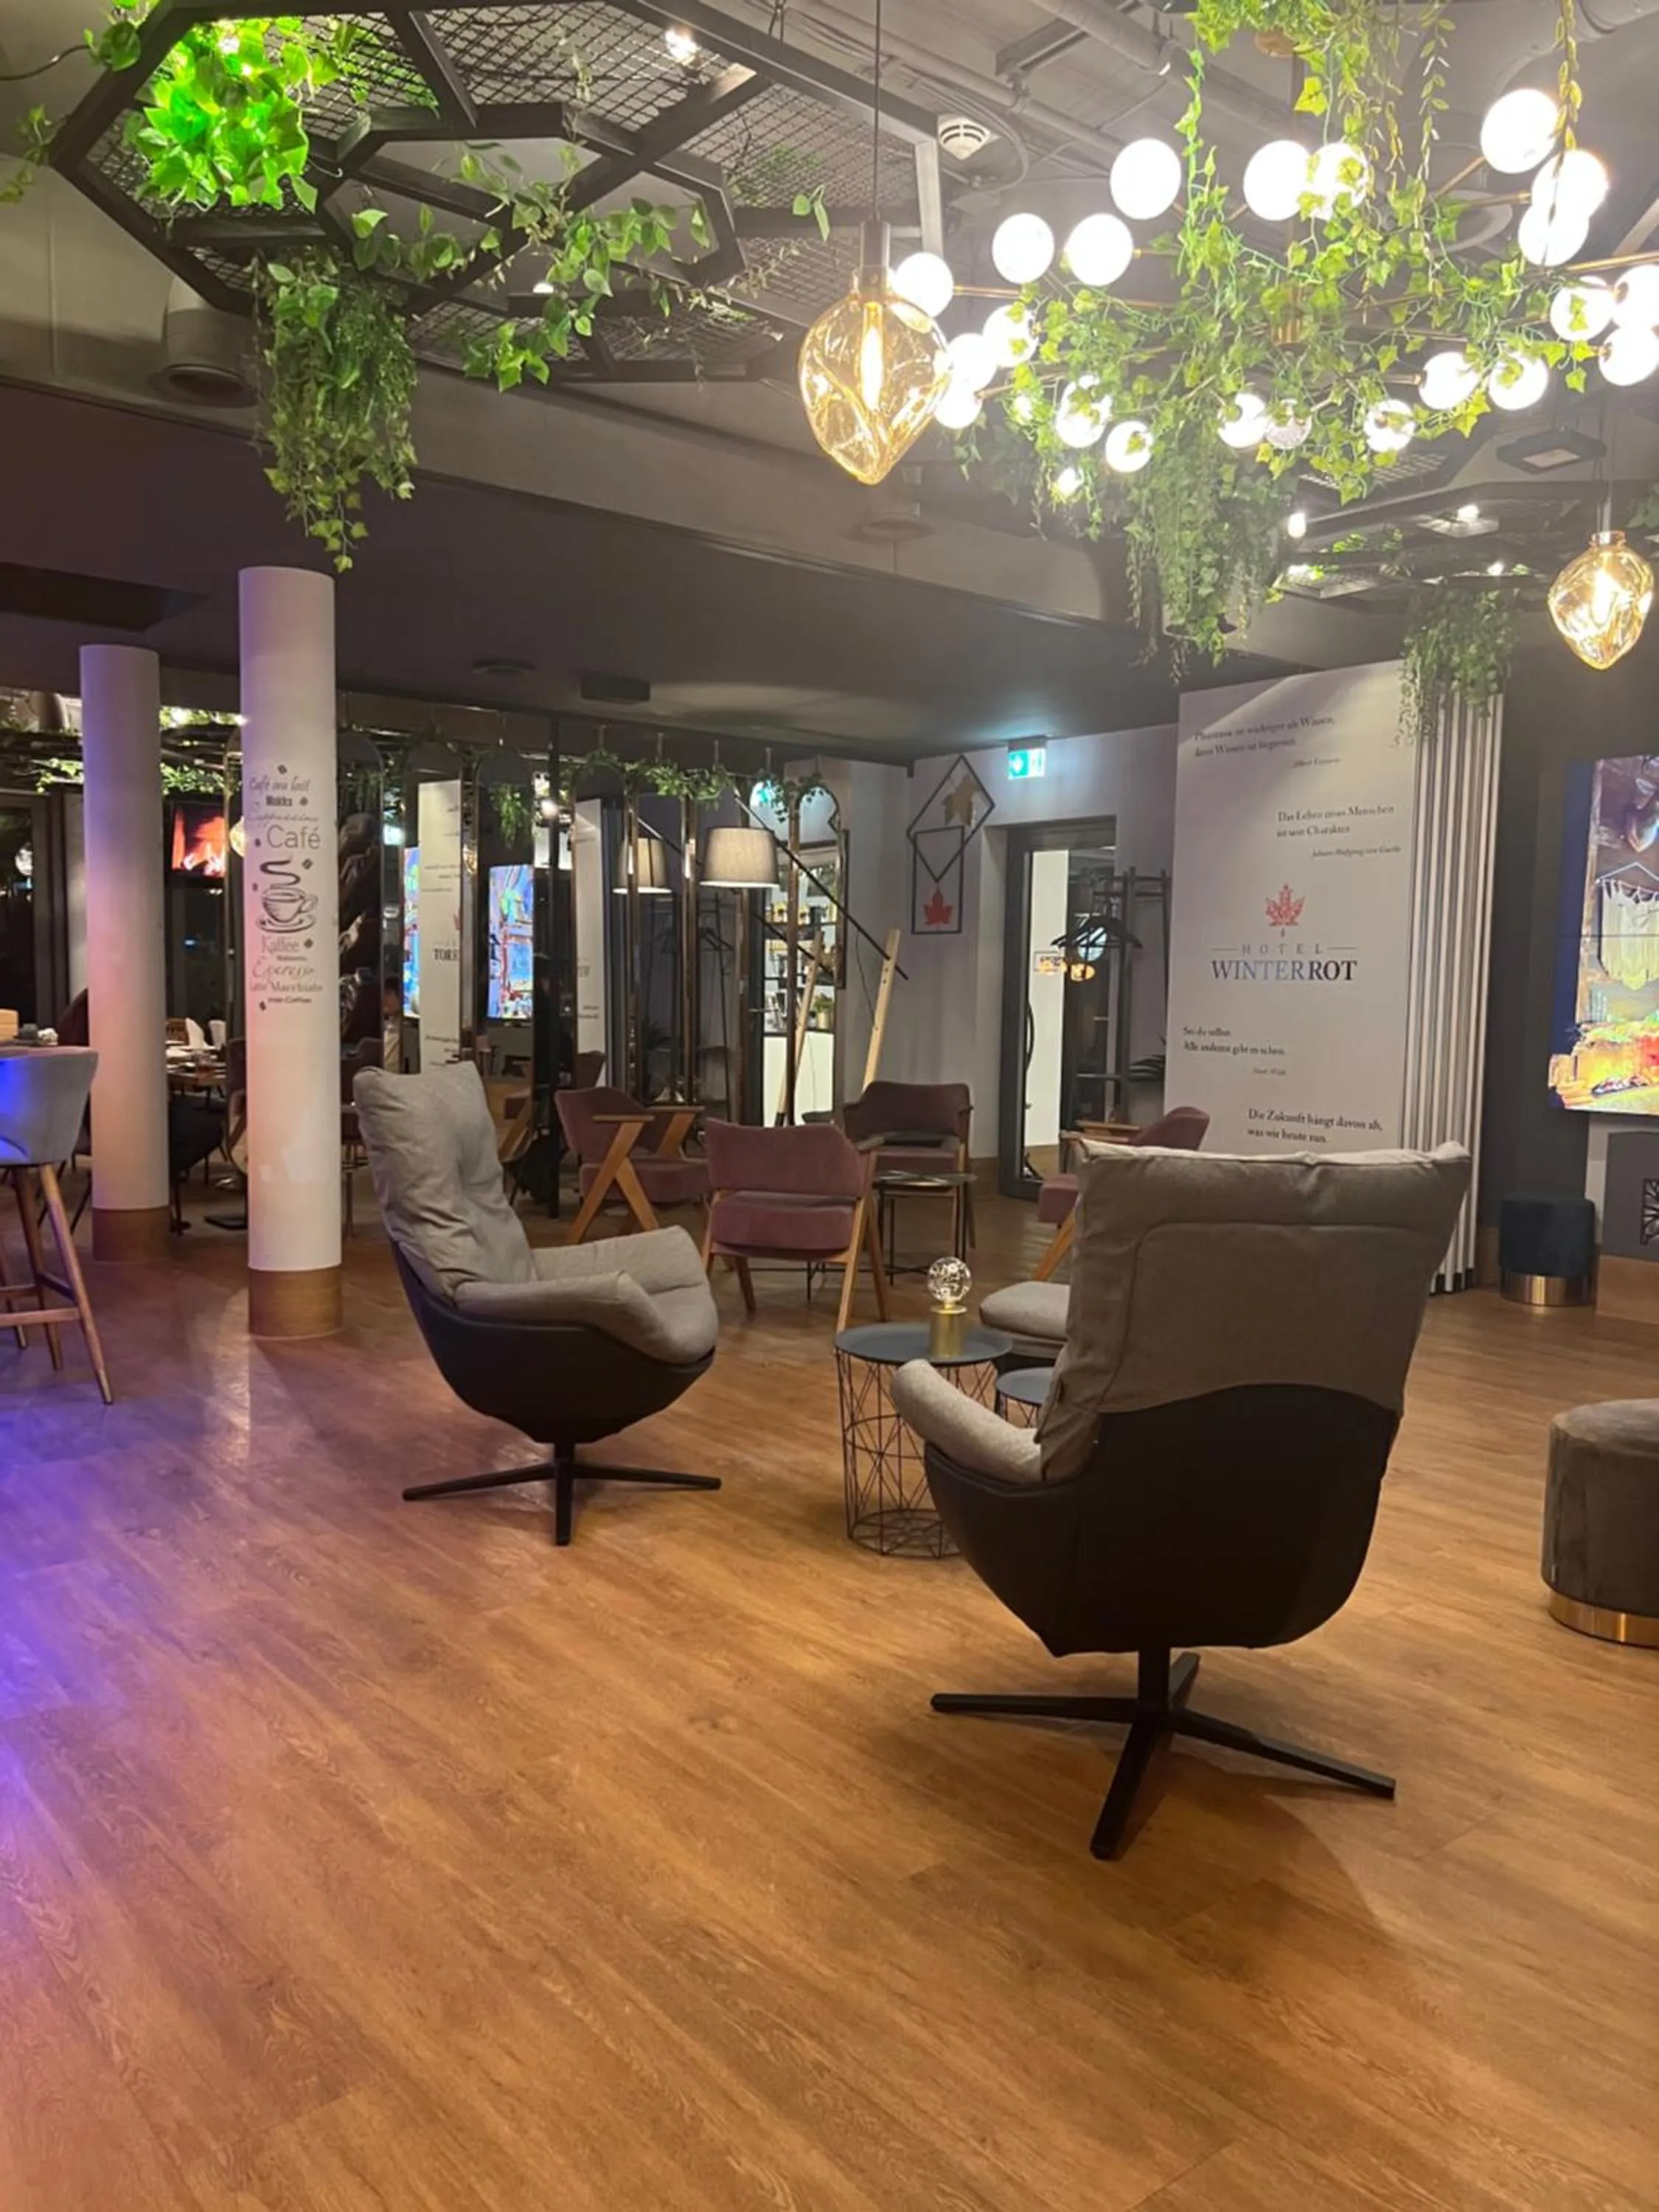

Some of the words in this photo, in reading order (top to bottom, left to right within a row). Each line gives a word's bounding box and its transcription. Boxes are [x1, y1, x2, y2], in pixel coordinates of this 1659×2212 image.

[267, 824, 321, 849] Café
[1242, 942, 1324, 956] HOTEL
[1211, 959, 1357, 981] WINTERROT
[1248, 1107, 1265, 1120] Die
[1266, 1108, 1305, 1124] Zukunft
[1336, 1114, 1366, 1130] davon
[1248, 1128, 1264, 1138] was
[1281, 1127, 1306, 1141] heute
